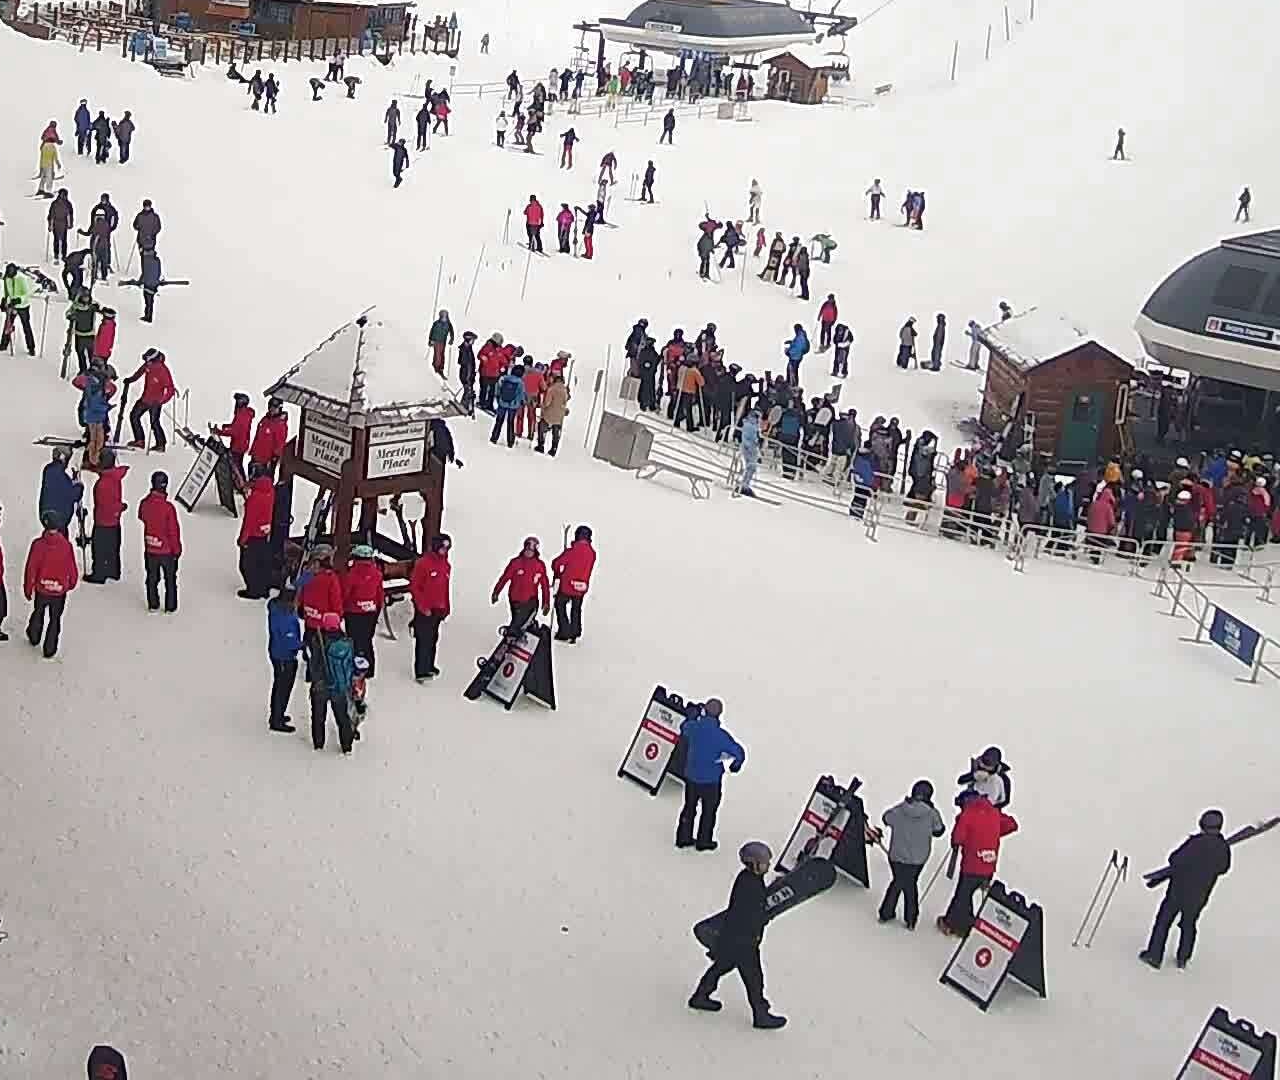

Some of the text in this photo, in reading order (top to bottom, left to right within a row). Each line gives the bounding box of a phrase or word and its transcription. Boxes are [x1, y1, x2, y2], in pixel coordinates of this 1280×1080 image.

[311, 433, 345, 457] Meeting
[314, 448, 340, 464] Place
[376, 446, 417, 460] Meeting
[382, 458, 410, 470] Place
